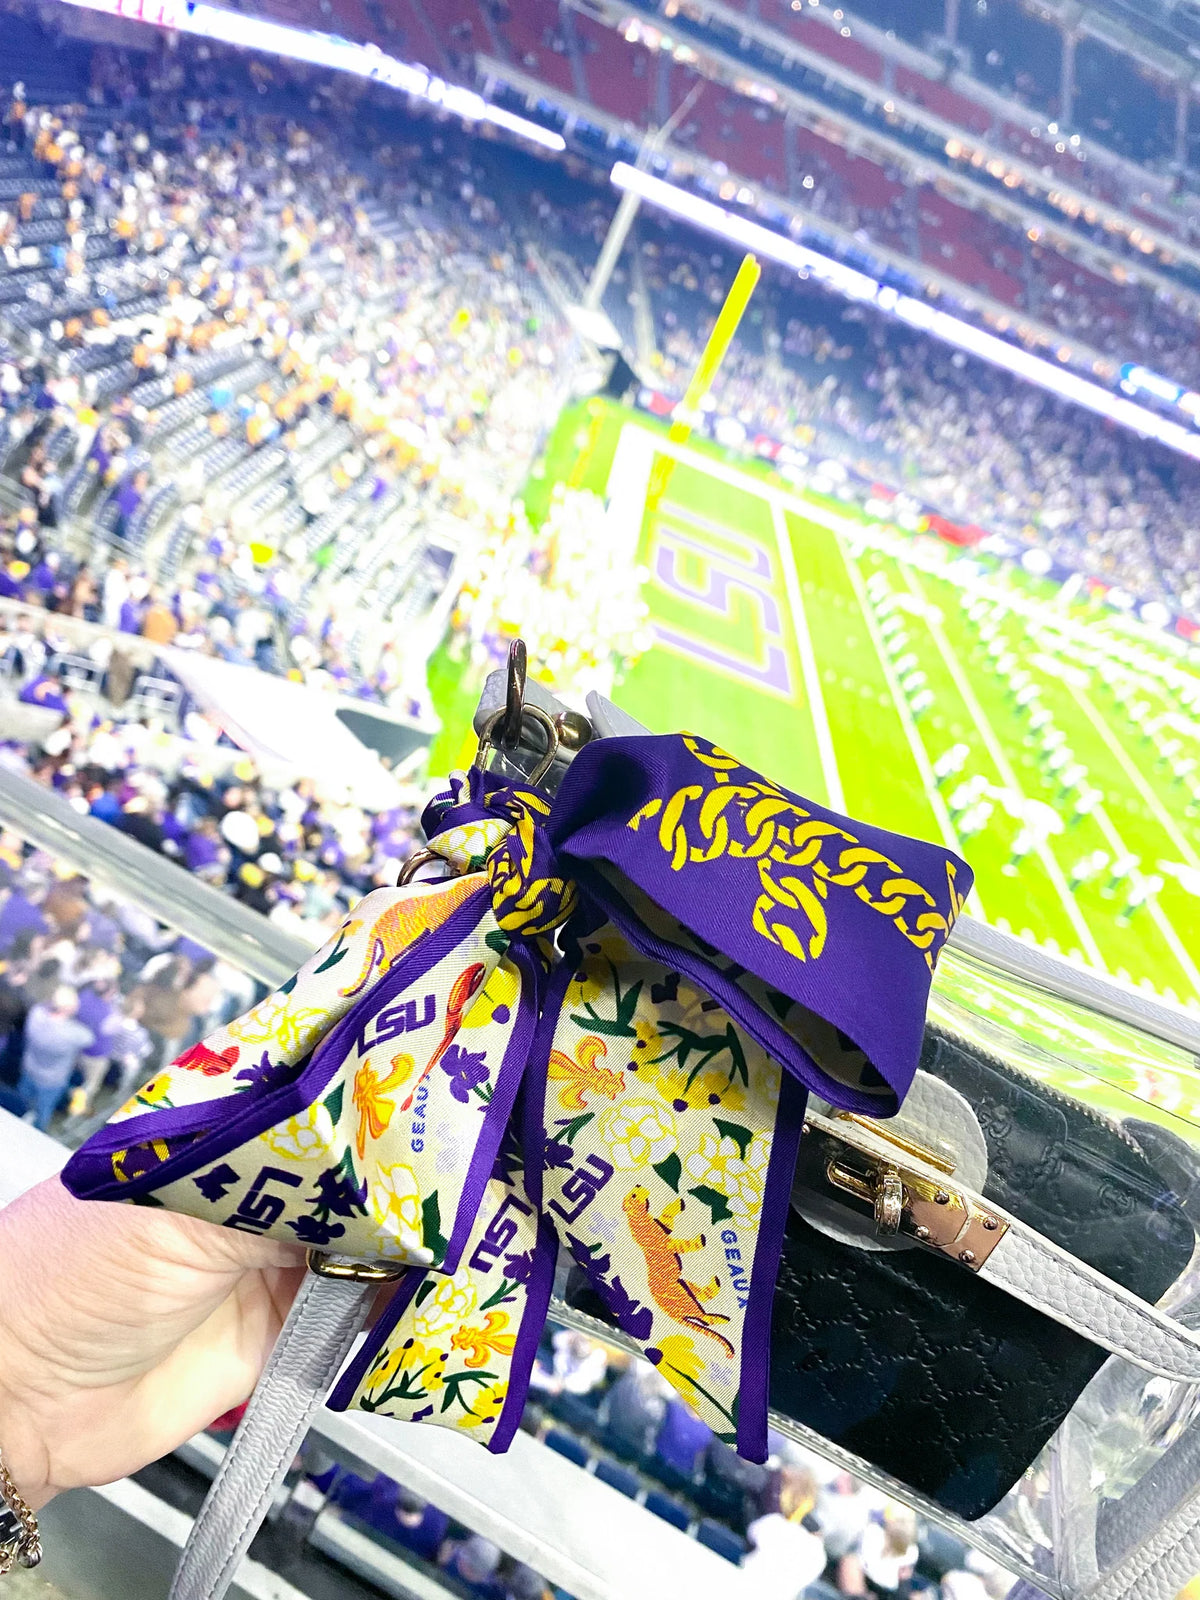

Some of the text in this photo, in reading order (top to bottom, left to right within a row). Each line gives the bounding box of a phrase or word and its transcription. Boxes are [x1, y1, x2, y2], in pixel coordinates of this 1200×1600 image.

[652, 499, 793, 697] LSU
[357, 994, 436, 1058] LSU
[411, 1074, 431, 1154] GEAU
[547, 1153, 615, 1225] LSU
[469, 1193, 534, 1274] LSU
